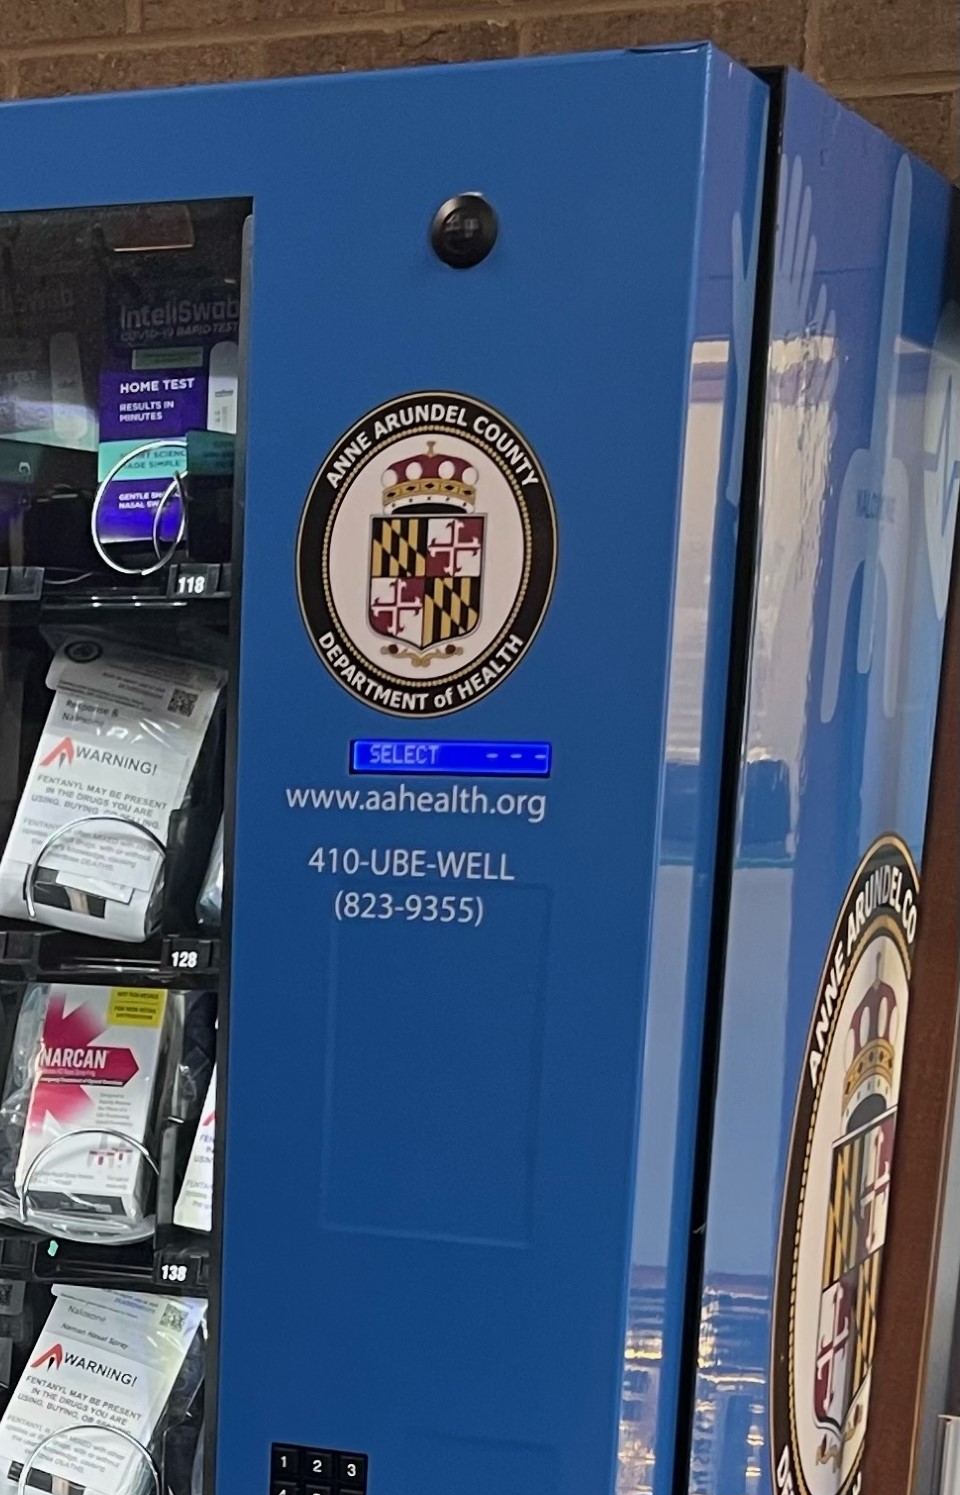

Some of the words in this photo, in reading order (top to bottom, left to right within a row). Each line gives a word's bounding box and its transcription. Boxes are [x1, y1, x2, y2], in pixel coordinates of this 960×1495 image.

[120, 380, 159, 394] HOME
[163, 378, 195, 390] TEST
[119, 402, 160, 412] RESULTS
[162, 400, 174, 410] IN
[119, 411, 163, 422] MINUTES
[326, 431, 373, 489] ANNE
[373, 403, 467, 440] ARUNDEL
[473, 416, 539, 486] COUNTY
[178, 577, 205, 594] 118
[318, 632, 429, 711] DEPARTMENT
[434, 689, 453, 710] of
[458, 634, 524, 700] HEALTH
[76, 746, 157, 776] WARNING!
[370, 744, 439, 764] SELECT
[38, 775, 83, 790] FENTANYL
[86, 785, 107, 795] MAY
[109, 790, 121, 799] BE
[125, 794, 167, 809] PRESENT
[58, 788, 74, 798] THE
[77, 792, 109, 807] DRUGS
[112, 801, 132, 812] YOU
[134, 807, 154, 817] ARE
[286, 784, 546, 823] www.aahealth.org
[308, 848, 515, 880] 410-UBE-WELL
[335, 890, 483, 926] (823-9355)
[172, 952, 197, 967] 128
[808, 941, 846, 1088] ANNE
[847, 864, 903, 956] ARUNDEL
[40, 1048, 107, 1069] NARCAN
[162, 1265, 186, 1281] 138
[64, 1352, 139, 1387] WARNING!
[26, 1376, 67, 1395] FENTANYL
[70, 1389, 88, 1401] MAY
[90, 1397, 101, 1406] BE
[102, 1401, 142, 1420] PRESENT
[42, 1391, 57, 1401] THE
[59, 1395, 88, 1412] DRUGS
[91, 1406, 108, 1419] YOU
[110, 1414, 128, 1426] ARE
[281, 1456, 287, 1468] 1
[312, 1460, 322, 1473] 2
[347, 1464, 356, 1476] 3
